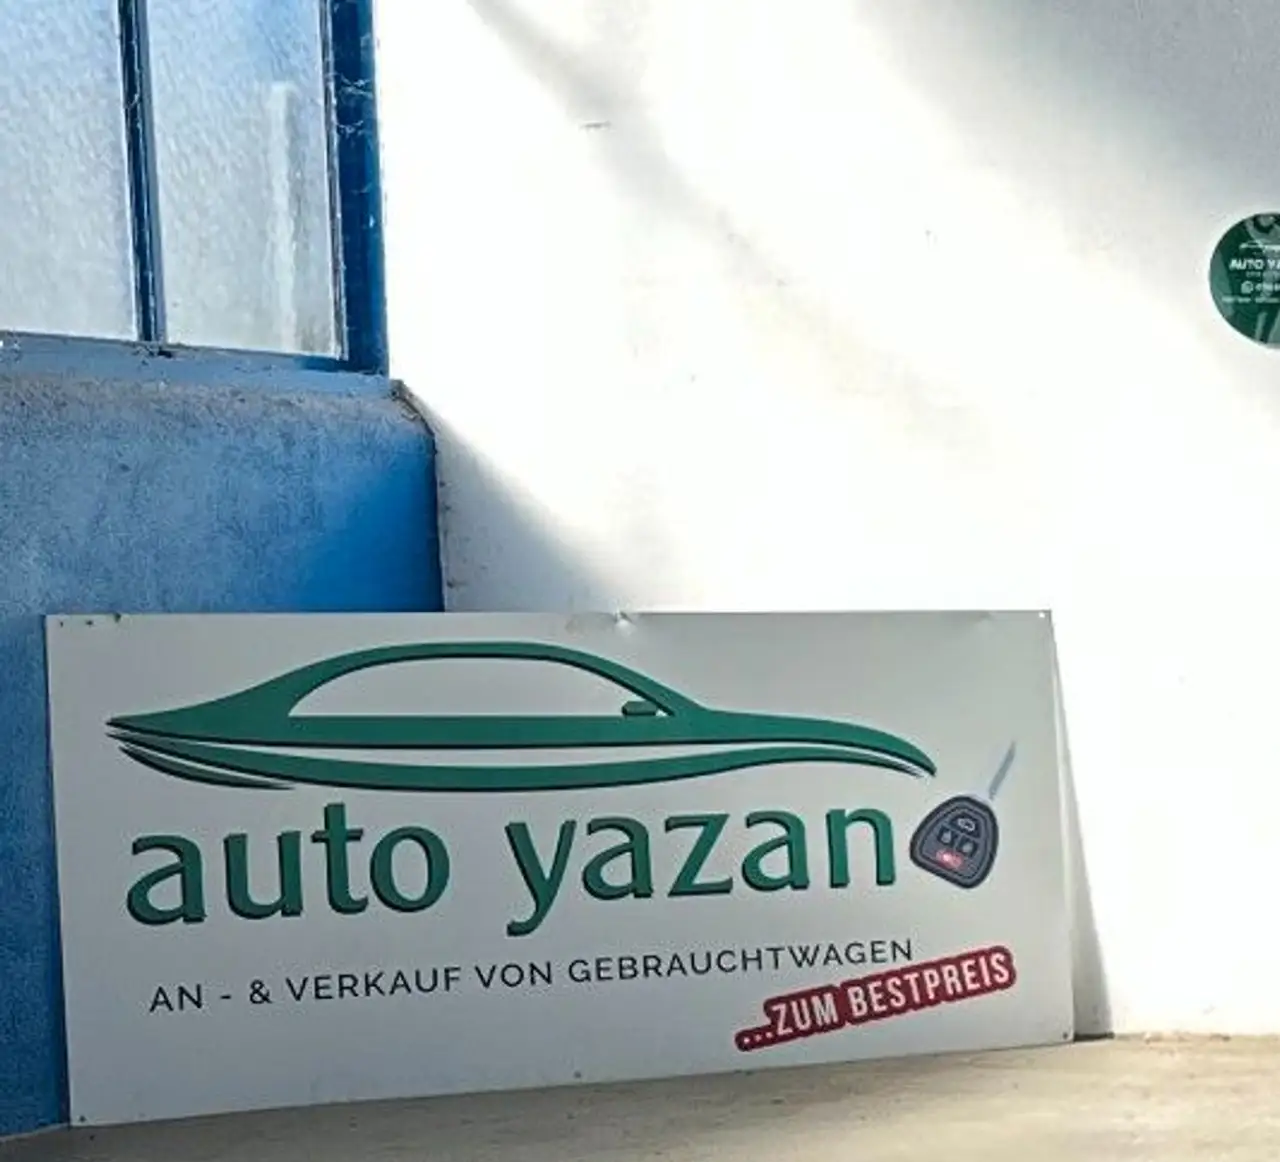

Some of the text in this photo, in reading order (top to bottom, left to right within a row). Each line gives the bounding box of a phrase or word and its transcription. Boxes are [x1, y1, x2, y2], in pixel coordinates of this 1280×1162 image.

[1229, 258, 1264, 271] AUTO
[126, 803, 896, 937] auto yazan
[149, 984, 203, 1013] AN
[249, 979, 273, 1005] &
[286, 966, 462, 1001] VERKAUF
[474, 961, 552, 989] VON
[568, 939, 914, 983] GEBRAUCHTWAGEN
[849, 951, 1013, 1019] BESTPREIS
